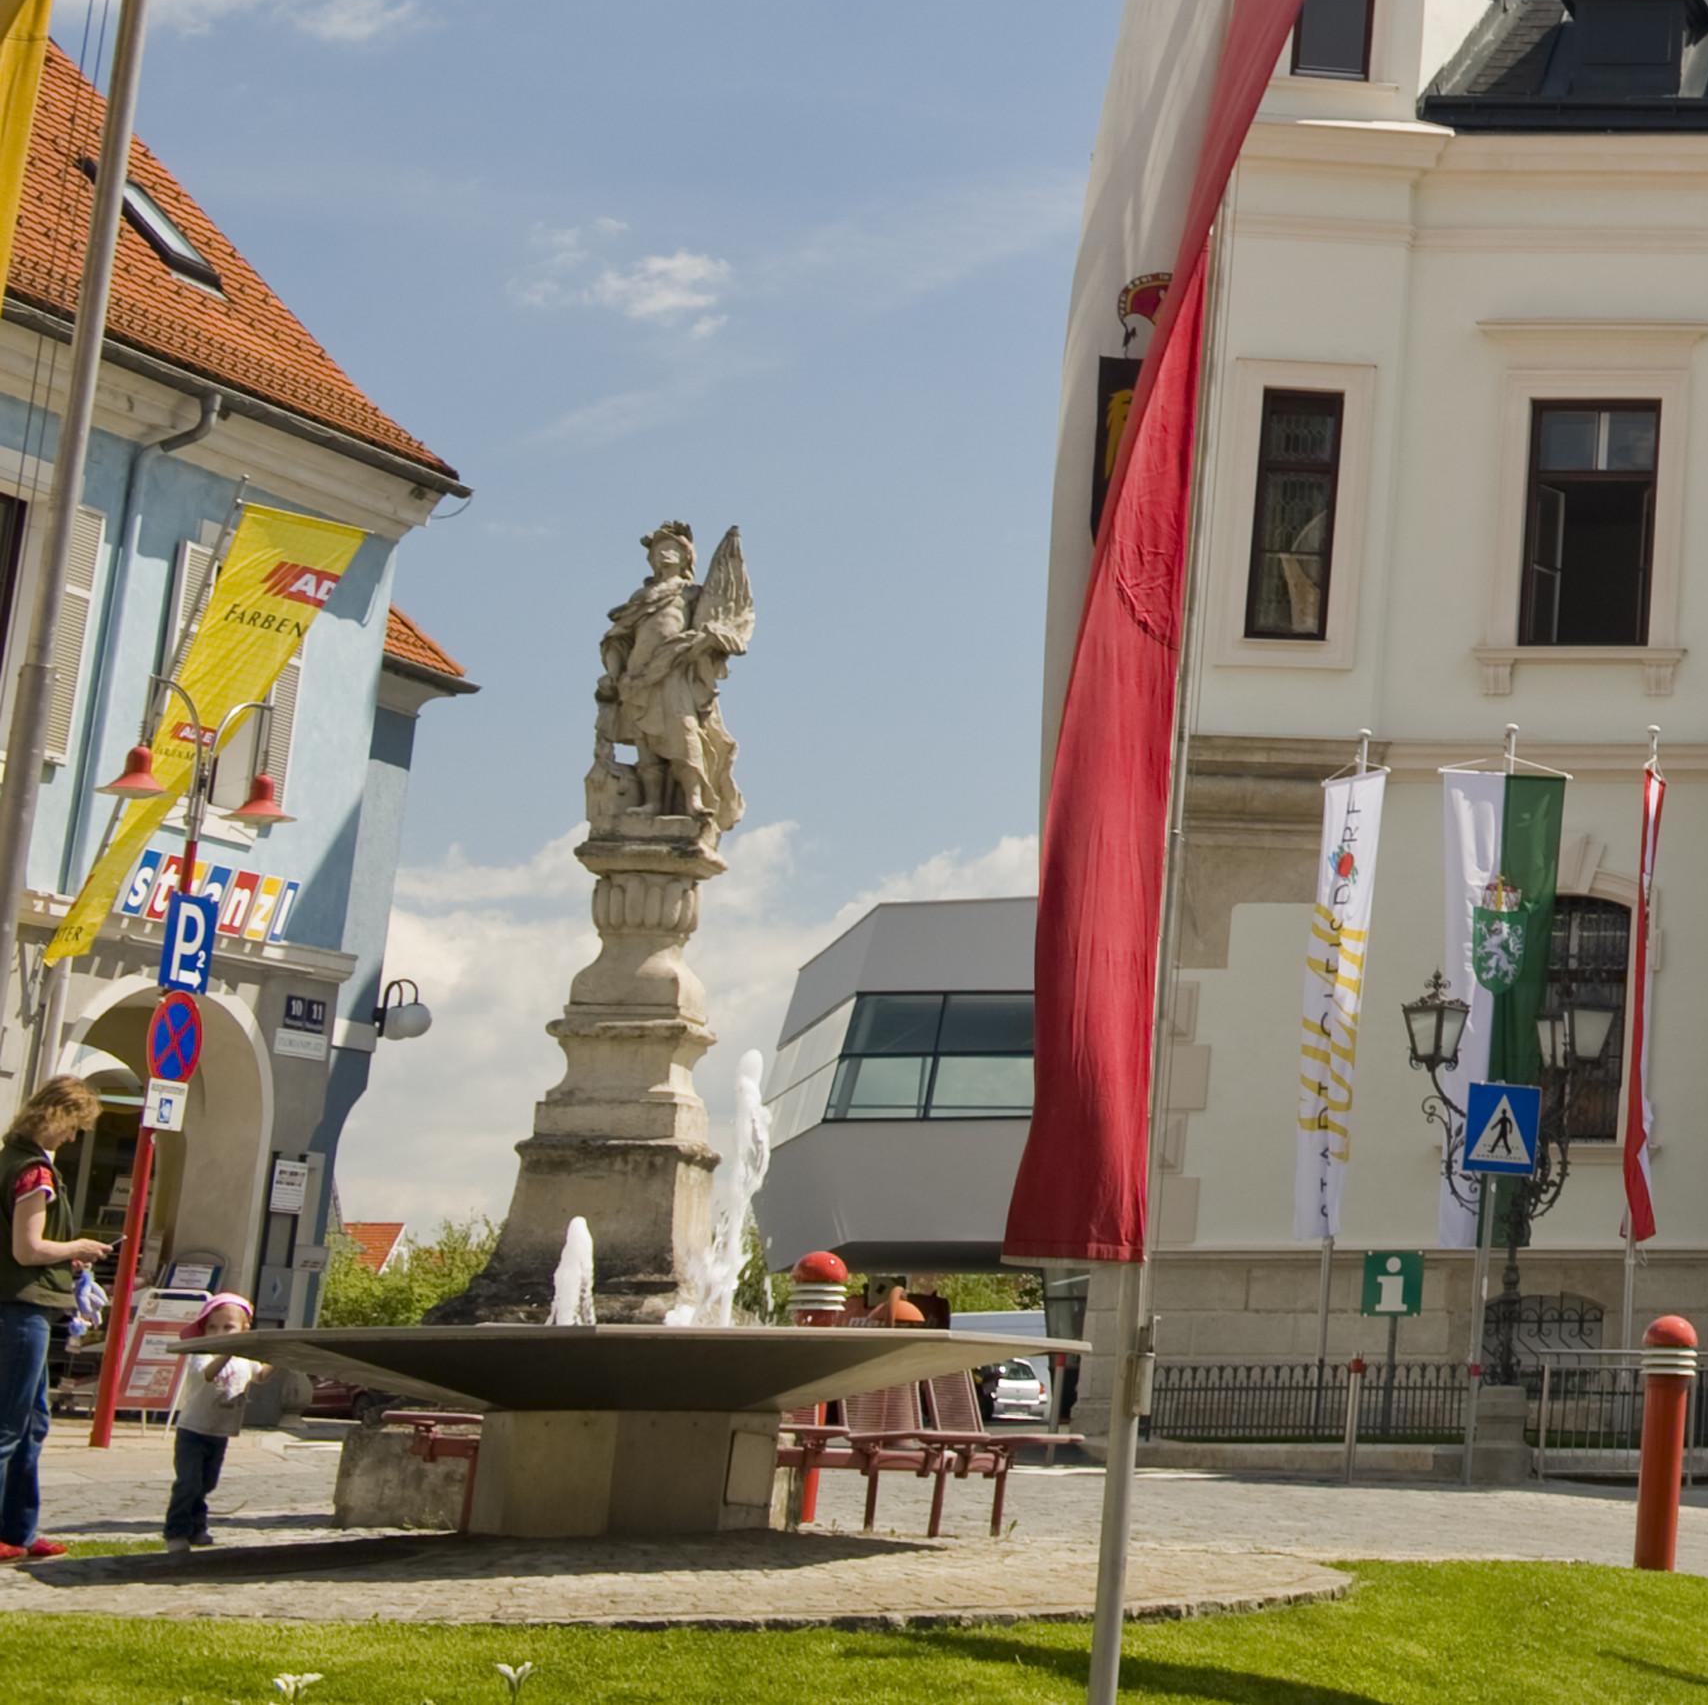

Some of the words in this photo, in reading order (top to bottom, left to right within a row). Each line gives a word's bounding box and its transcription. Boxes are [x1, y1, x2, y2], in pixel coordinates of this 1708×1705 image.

[224, 604, 308, 638] FARBEN
[127, 864, 295, 935] stnzl
[169, 901, 206, 981] P
[196, 950, 206, 968] 2
[291, 999, 303, 1016] 10
[312, 1003, 323, 1021] 11
